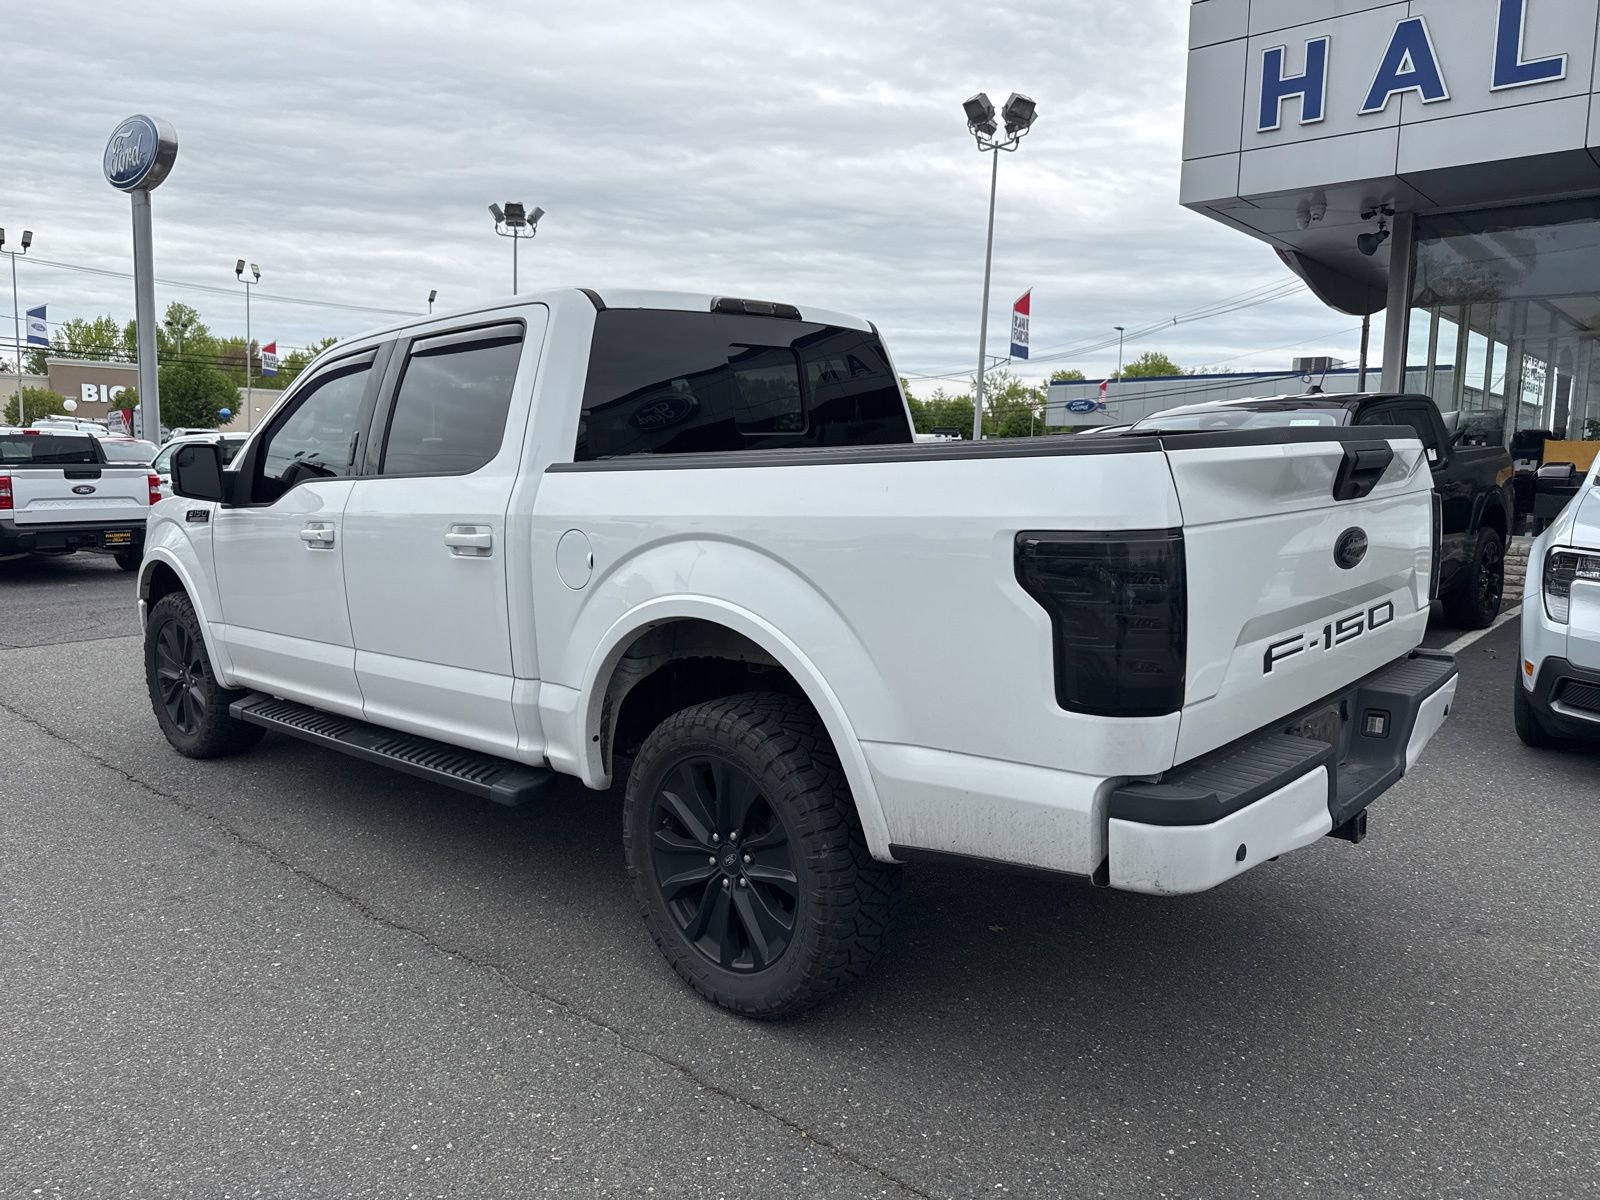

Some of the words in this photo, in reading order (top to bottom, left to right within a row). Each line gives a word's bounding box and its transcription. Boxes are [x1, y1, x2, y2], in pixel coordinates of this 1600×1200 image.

[1257, 0, 1568, 133] HAL
[110, 129, 143, 177] Ford
[1070, 401, 1089, 411] Ford
[1263, 599, 1393, 675] F-150
